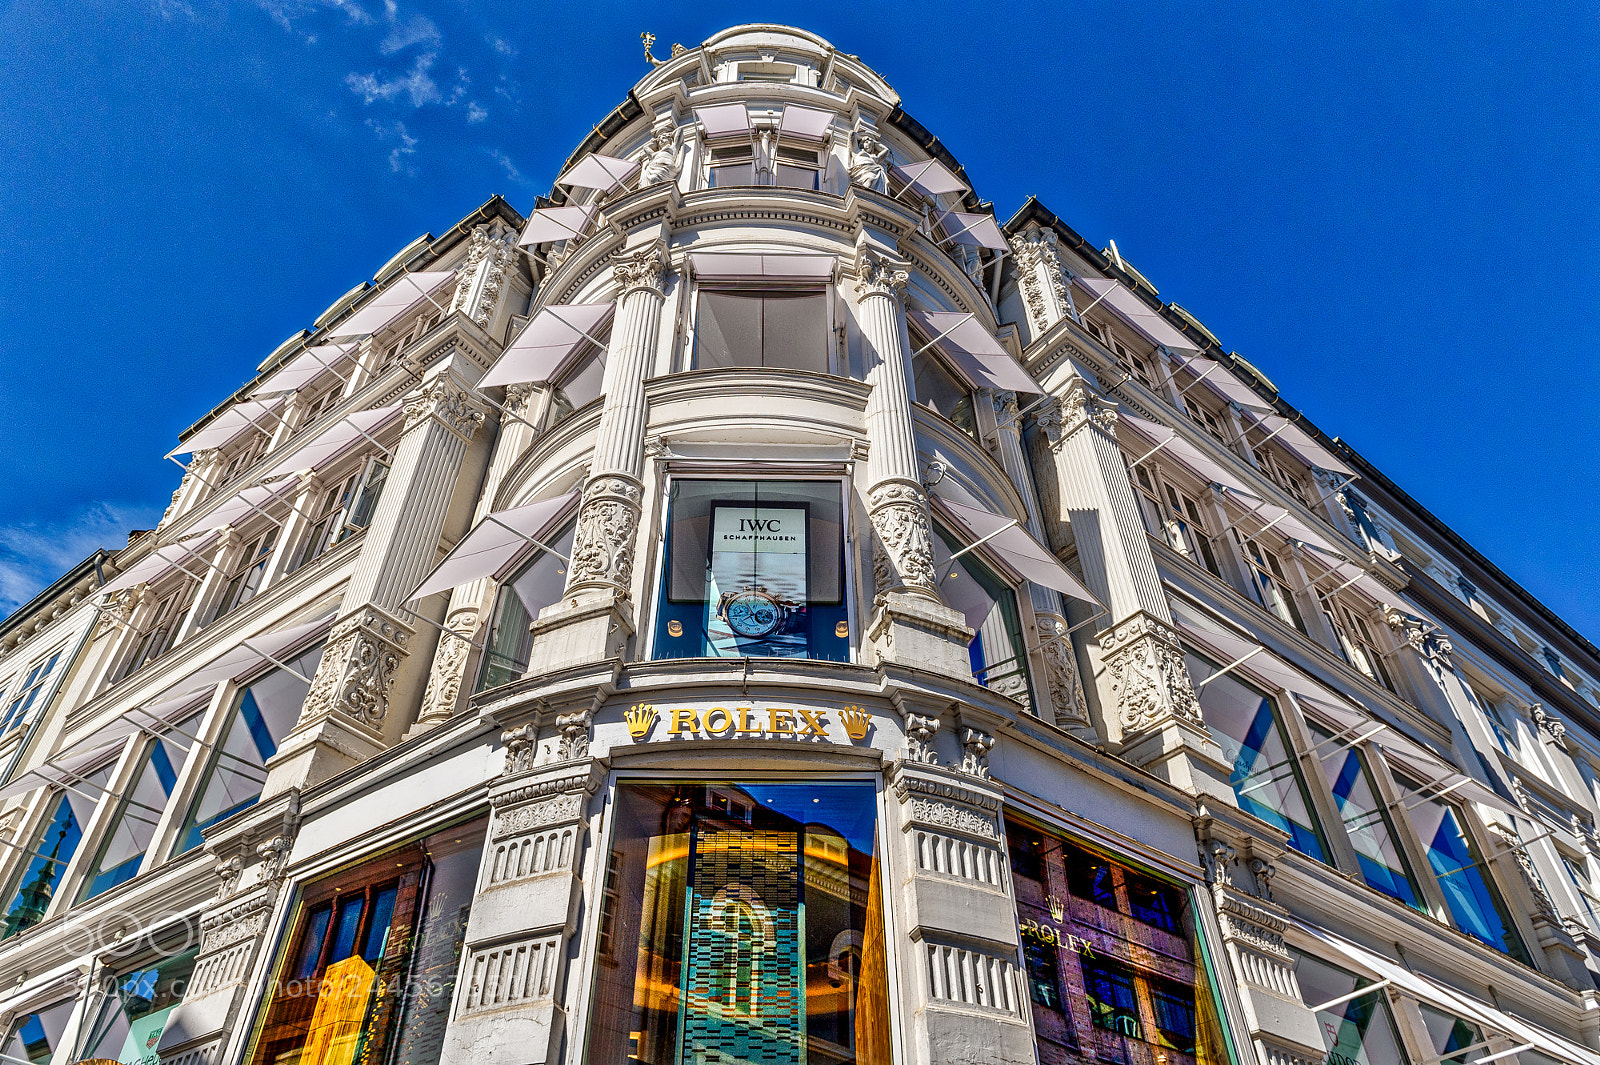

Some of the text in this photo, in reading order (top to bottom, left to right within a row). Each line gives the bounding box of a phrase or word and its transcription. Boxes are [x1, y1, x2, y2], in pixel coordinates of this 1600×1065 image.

[738, 518, 781, 532] IWC
[667, 706, 829, 737] ROLEX
[1025, 917, 1097, 960] ROLEX
